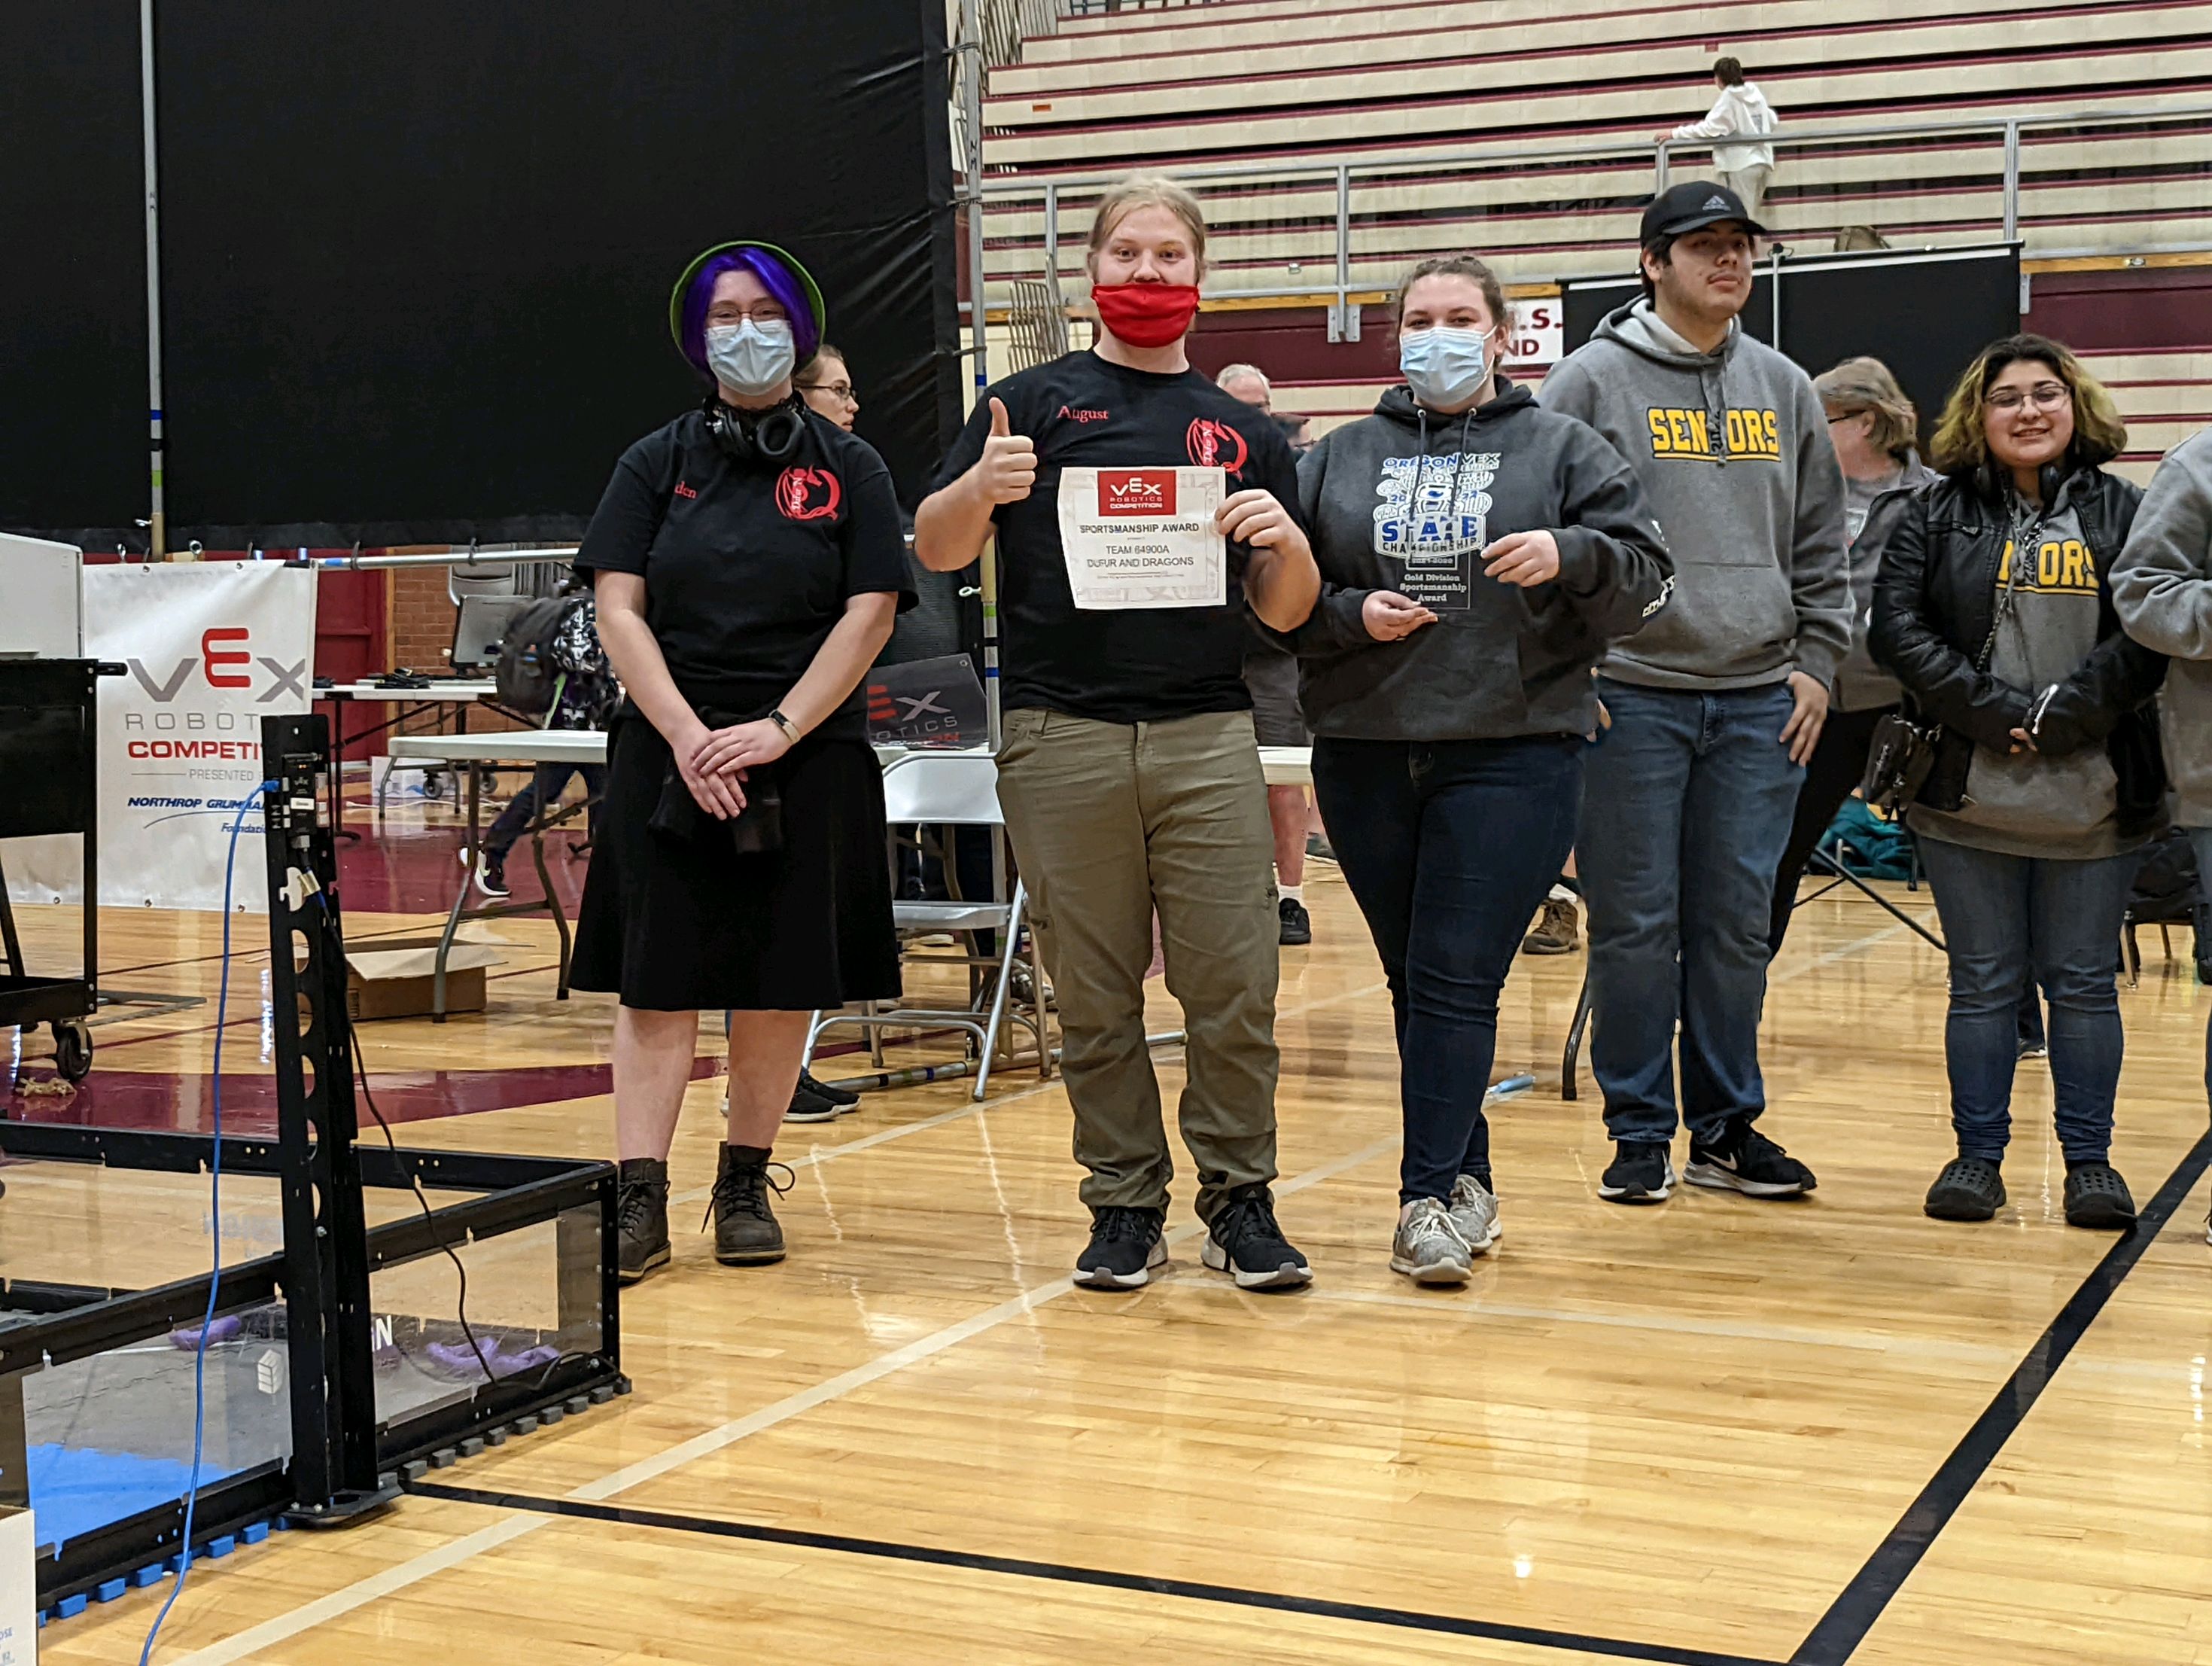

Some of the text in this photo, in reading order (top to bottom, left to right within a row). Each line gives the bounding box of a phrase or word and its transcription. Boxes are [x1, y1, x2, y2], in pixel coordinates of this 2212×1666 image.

[1056, 405, 1109, 423] August
[1647, 407, 1781, 454] SENORS
[1462, 452, 1501, 465] VEX
[1110, 477, 1162, 496] VEX
[1080, 522, 1199, 534] SPORTSMANSHIP AWARD
[1106, 545, 1131, 555] TEAM
[1087, 557, 1194, 568] DUFUR AND DRAGONS
[1400, 583, 1467, 592] Sportsmanship
[1417, 593, 1447, 602] Award
[126, 627, 306, 702] VEX
[867, 684, 951, 722] EX
[126, 713, 259, 730] ROBOT
[876, 716, 957, 740] OTICS
[128, 741, 262, 760] COMPETI
[189, 769, 254, 781] PRESENTED
[127, 796, 202, 809] NORTHROP
